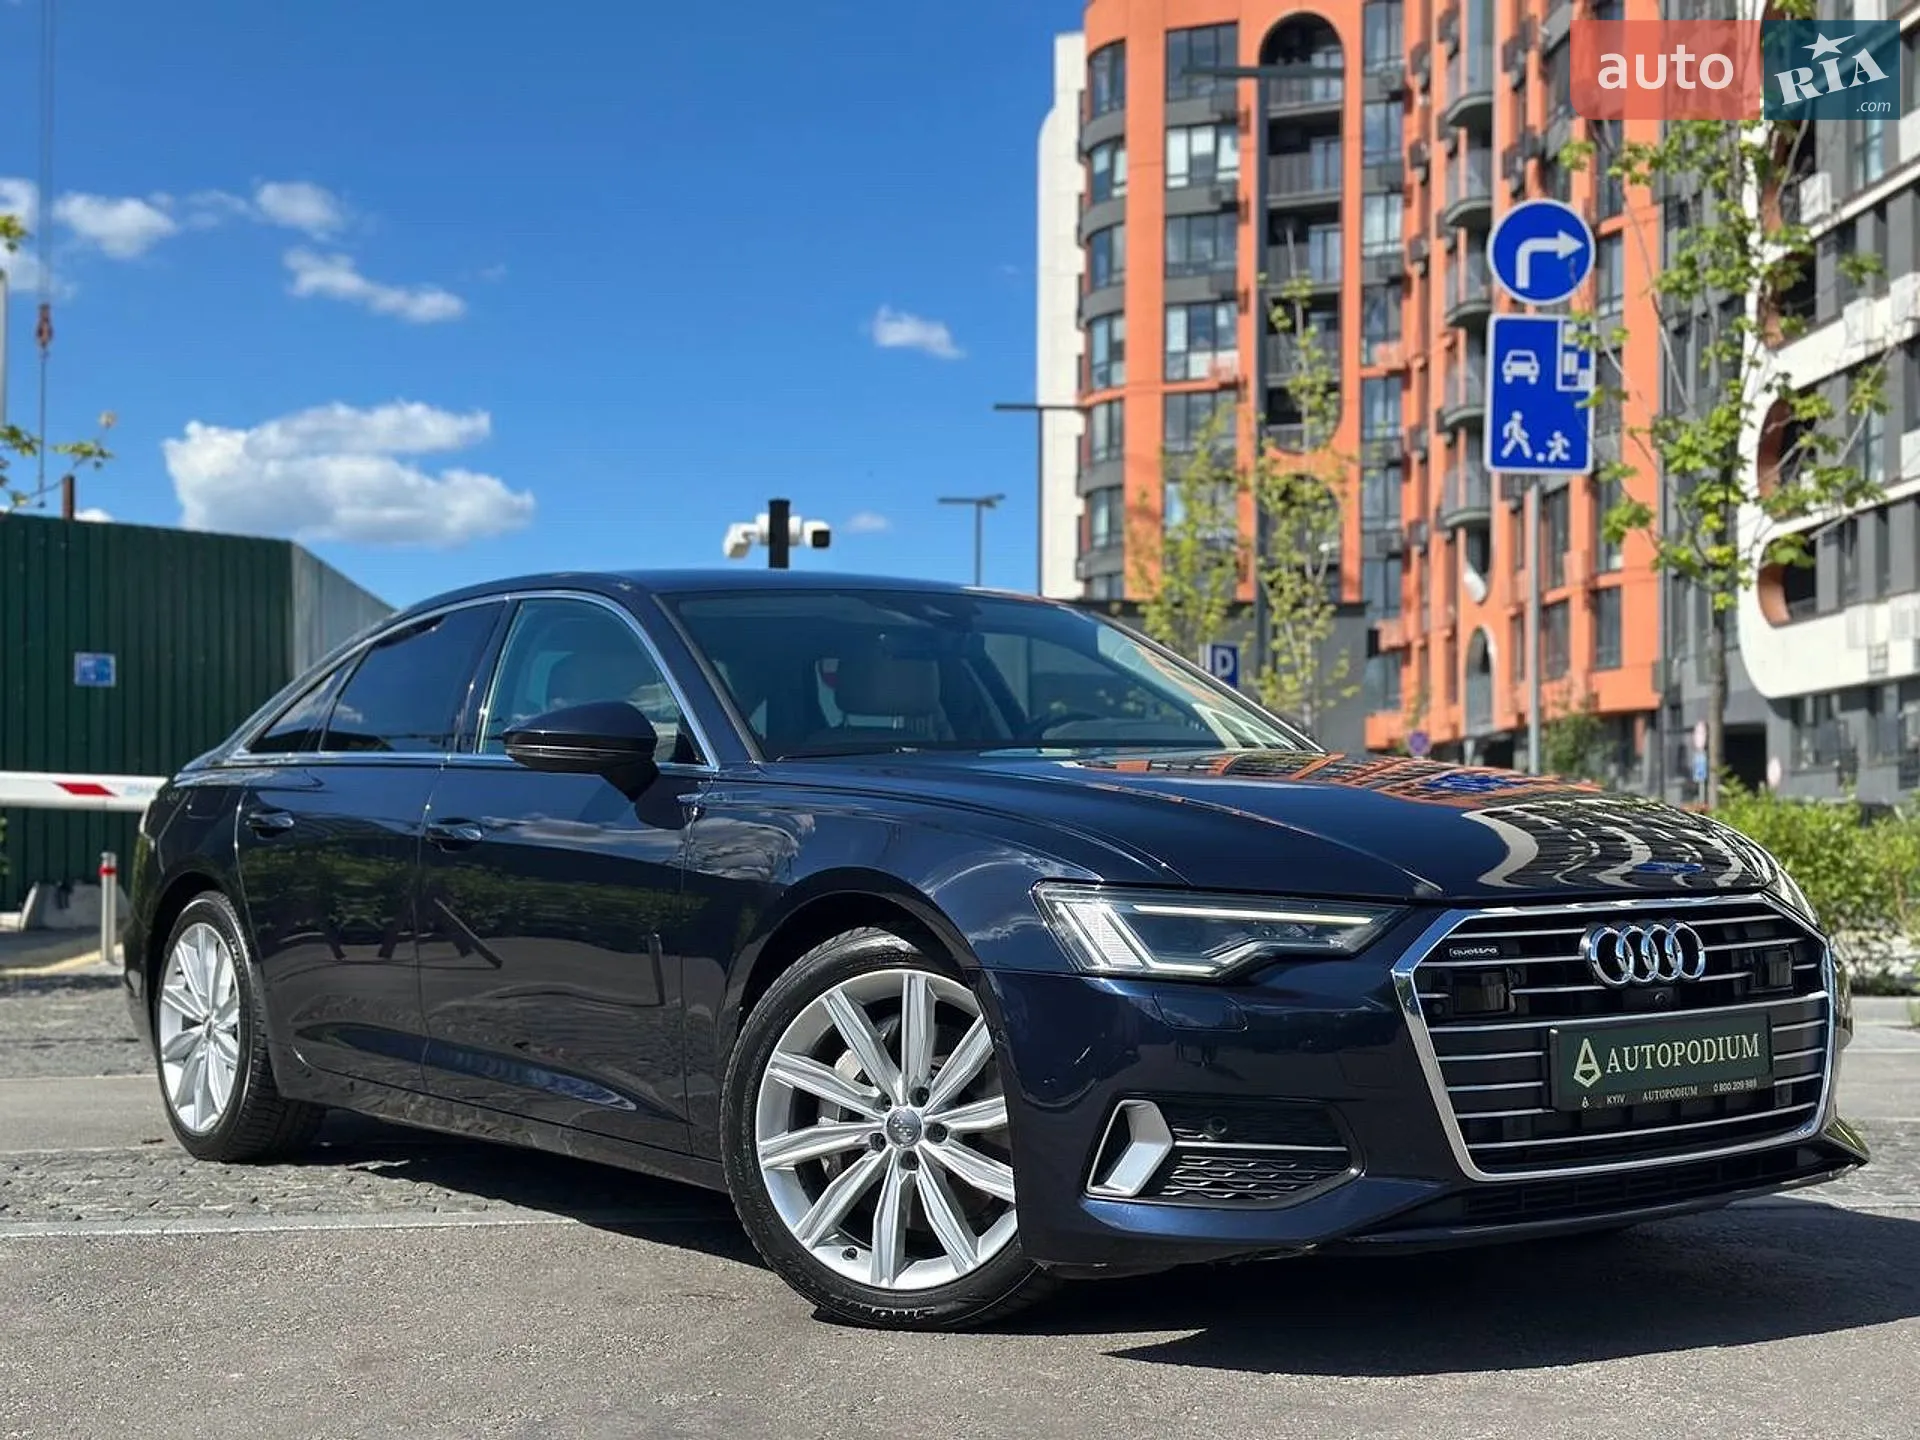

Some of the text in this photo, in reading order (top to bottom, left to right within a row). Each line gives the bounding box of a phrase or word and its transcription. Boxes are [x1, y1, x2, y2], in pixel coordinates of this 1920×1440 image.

[1452, 947, 1498, 956] quattro
[1606, 1033, 1760, 1074] AUTOPODIUM
[1606, 1094, 1626, 1105] KYIV
[1642, 1085, 1698, 1101] AUTOPODIUM
